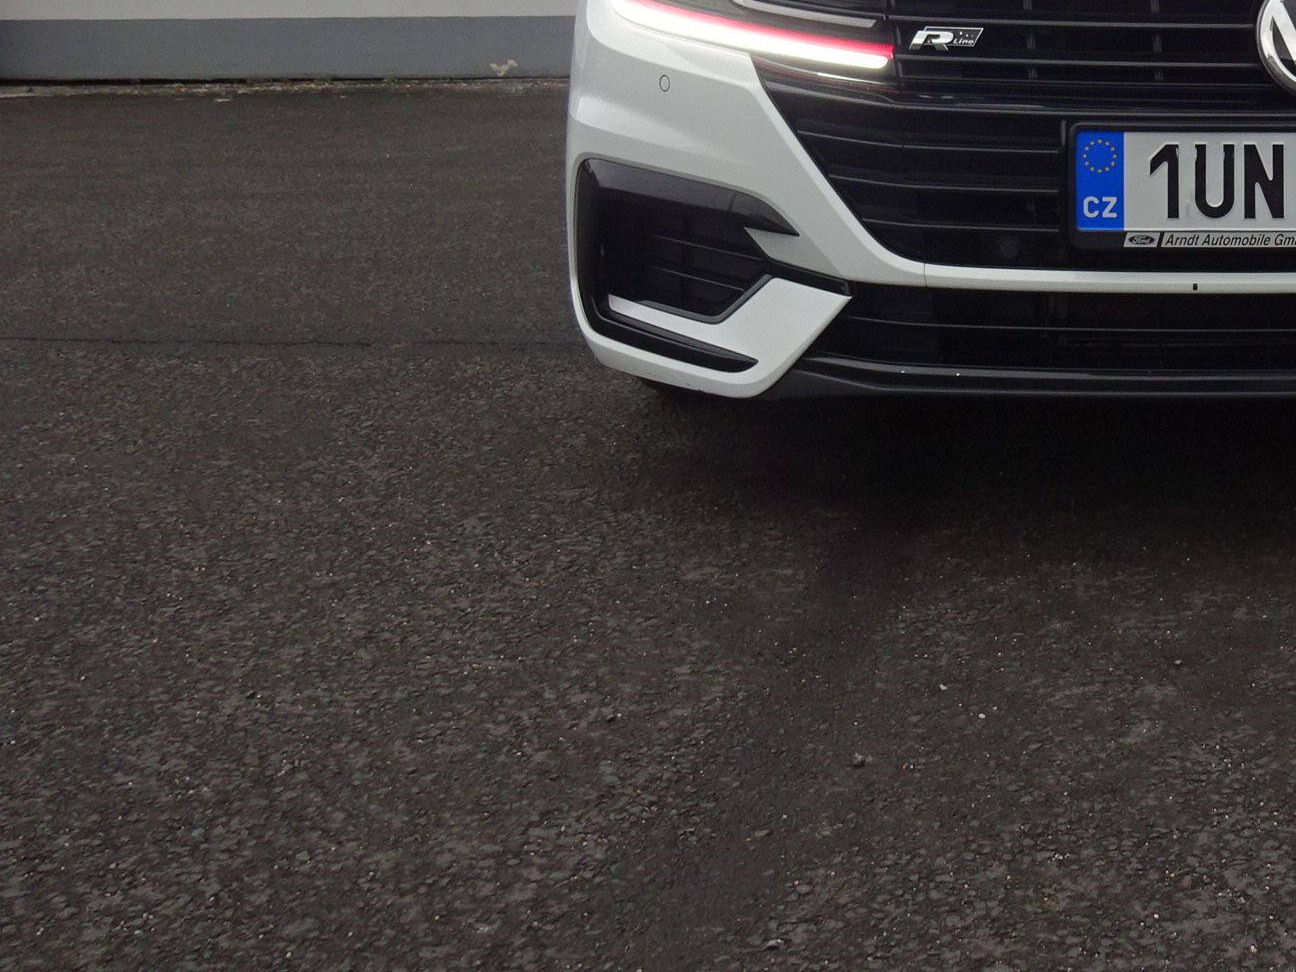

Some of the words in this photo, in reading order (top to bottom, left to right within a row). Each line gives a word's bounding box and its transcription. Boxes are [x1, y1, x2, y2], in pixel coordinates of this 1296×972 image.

[1149, 143, 1285, 219] 1UN
[1082, 196, 1118, 219] CZ
[1164, 233, 1200, 246] Arndt
[1201, 233, 1271, 246] Automobile
